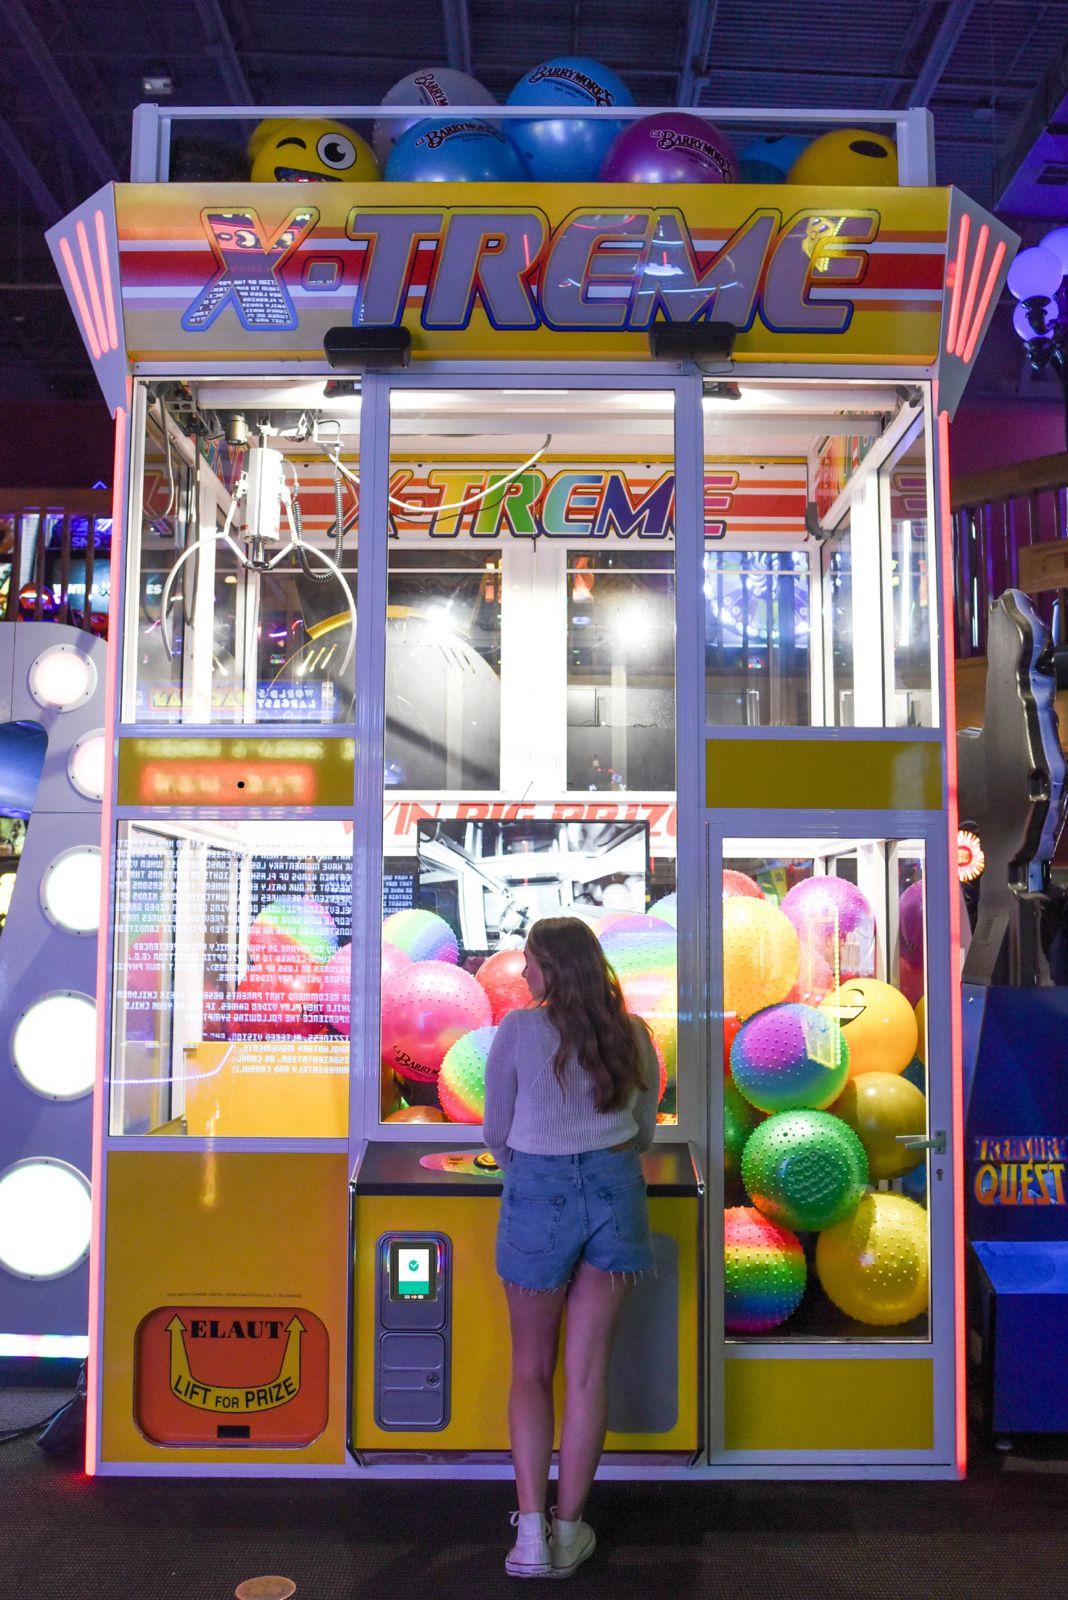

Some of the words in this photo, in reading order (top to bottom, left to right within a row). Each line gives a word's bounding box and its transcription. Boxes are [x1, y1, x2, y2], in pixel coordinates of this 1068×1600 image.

[528, 65, 616, 107] BARRYMORE'S
[182, 206, 881, 333] X-TREME
[974, 1163, 1066, 1205] QUEST
[190, 1320, 284, 1339] ELAUT
[173, 1375, 212, 1405] LIFT
[215, 1396, 240, 1409] FOR
[245, 1377, 297, 1408] PRIZE
